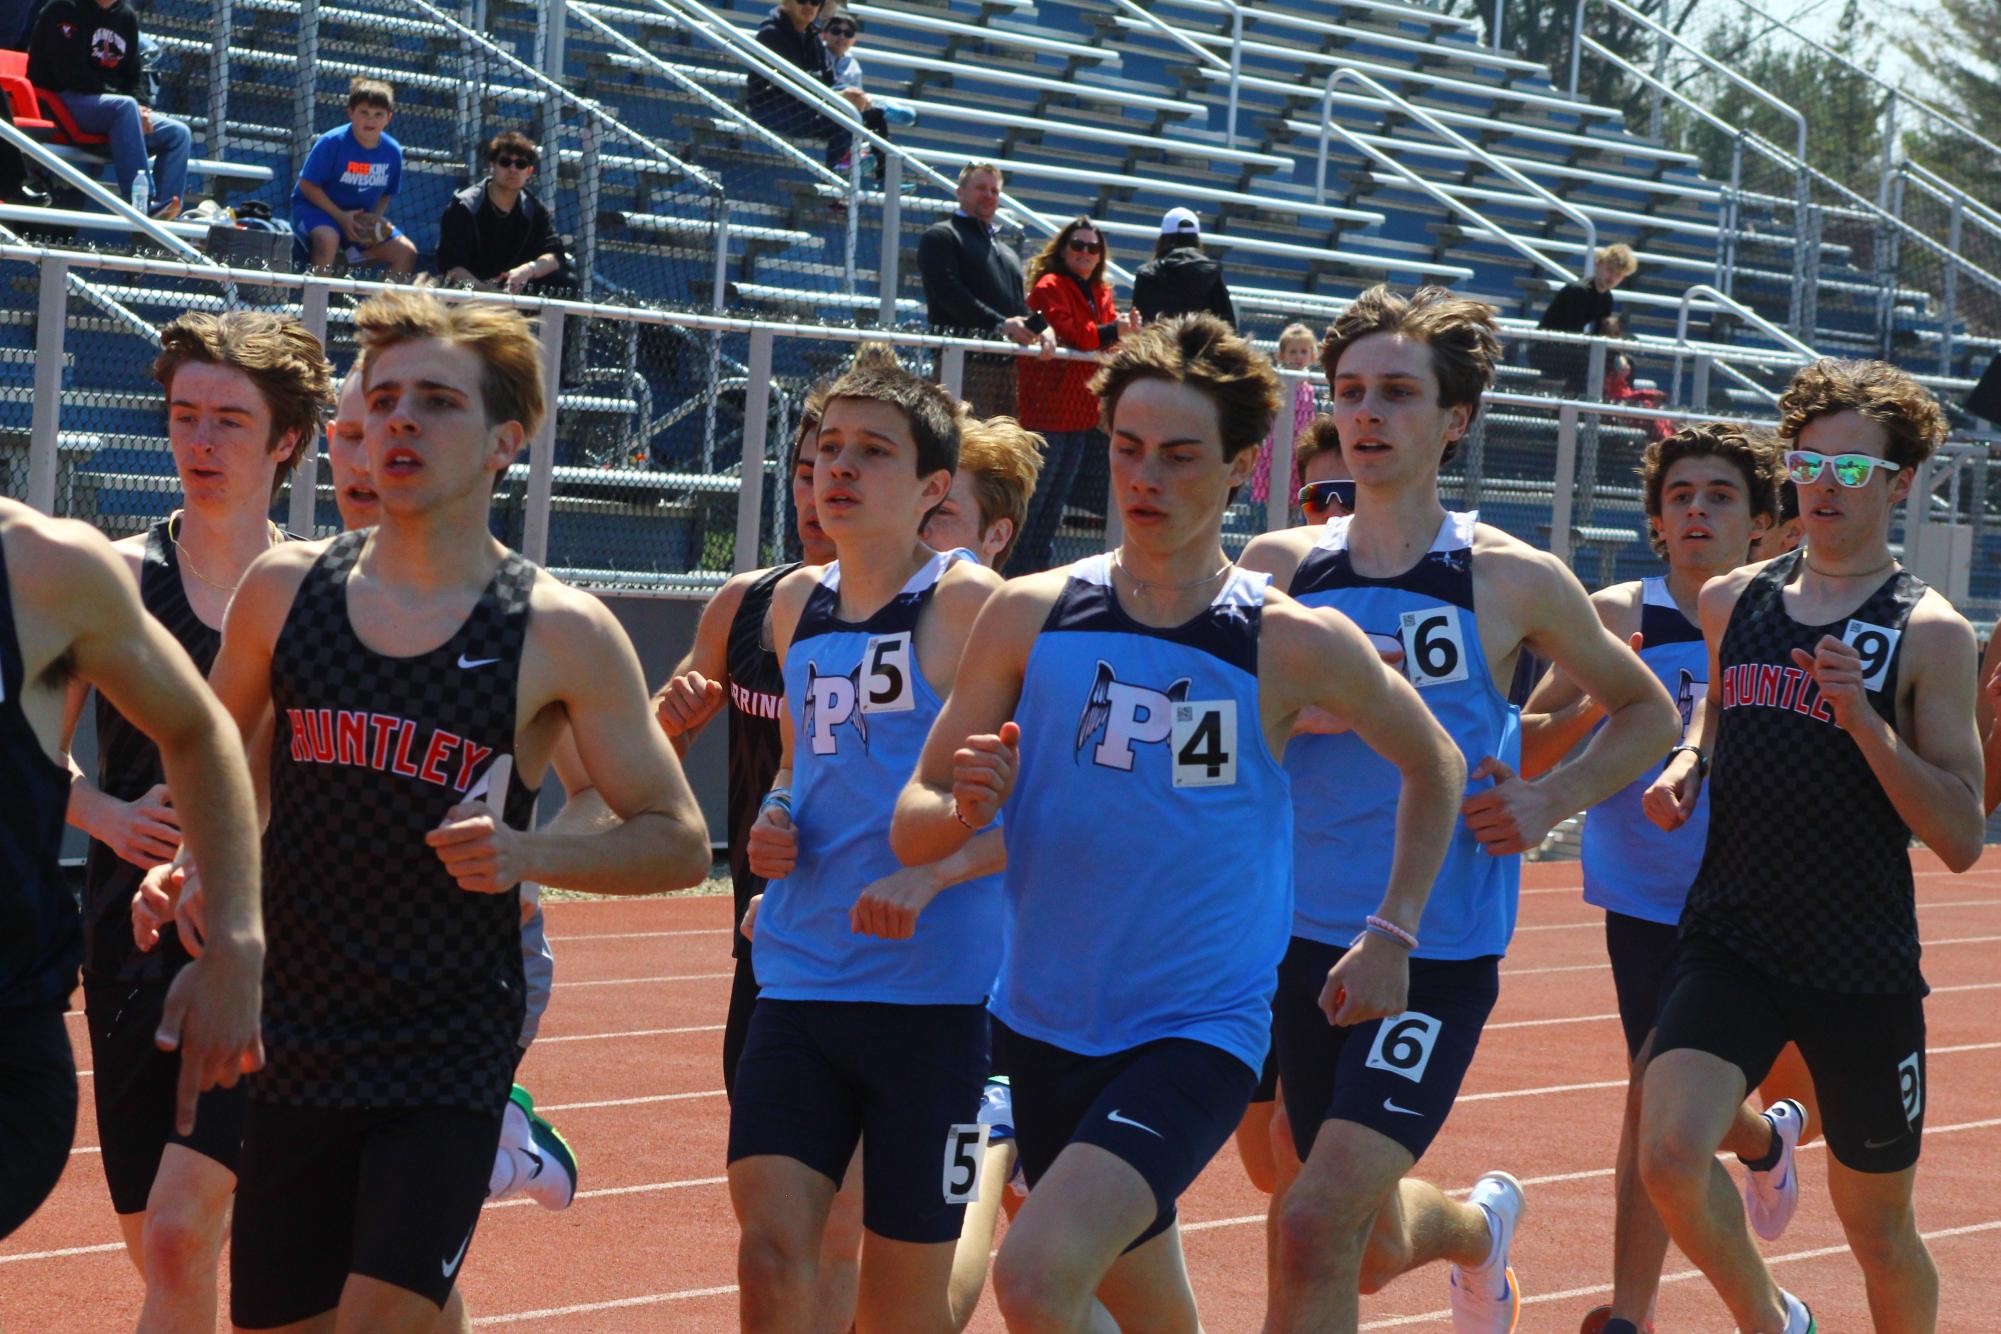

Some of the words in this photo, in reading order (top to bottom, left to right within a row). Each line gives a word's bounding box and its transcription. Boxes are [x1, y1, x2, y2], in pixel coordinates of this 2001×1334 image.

[869, 640, 903, 704] 5
[1414, 616, 1458, 677] 6
[1852, 631, 1890, 679] 9
[811, 675, 856, 756] P
[1092, 680, 1173, 772] P
[1178, 711, 1229, 777] 4
[286, 709, 492, 792] HUNTLEY
[1381, 1019, 1429, 1069] 6
[950, 1132, 980, 1195] 5
